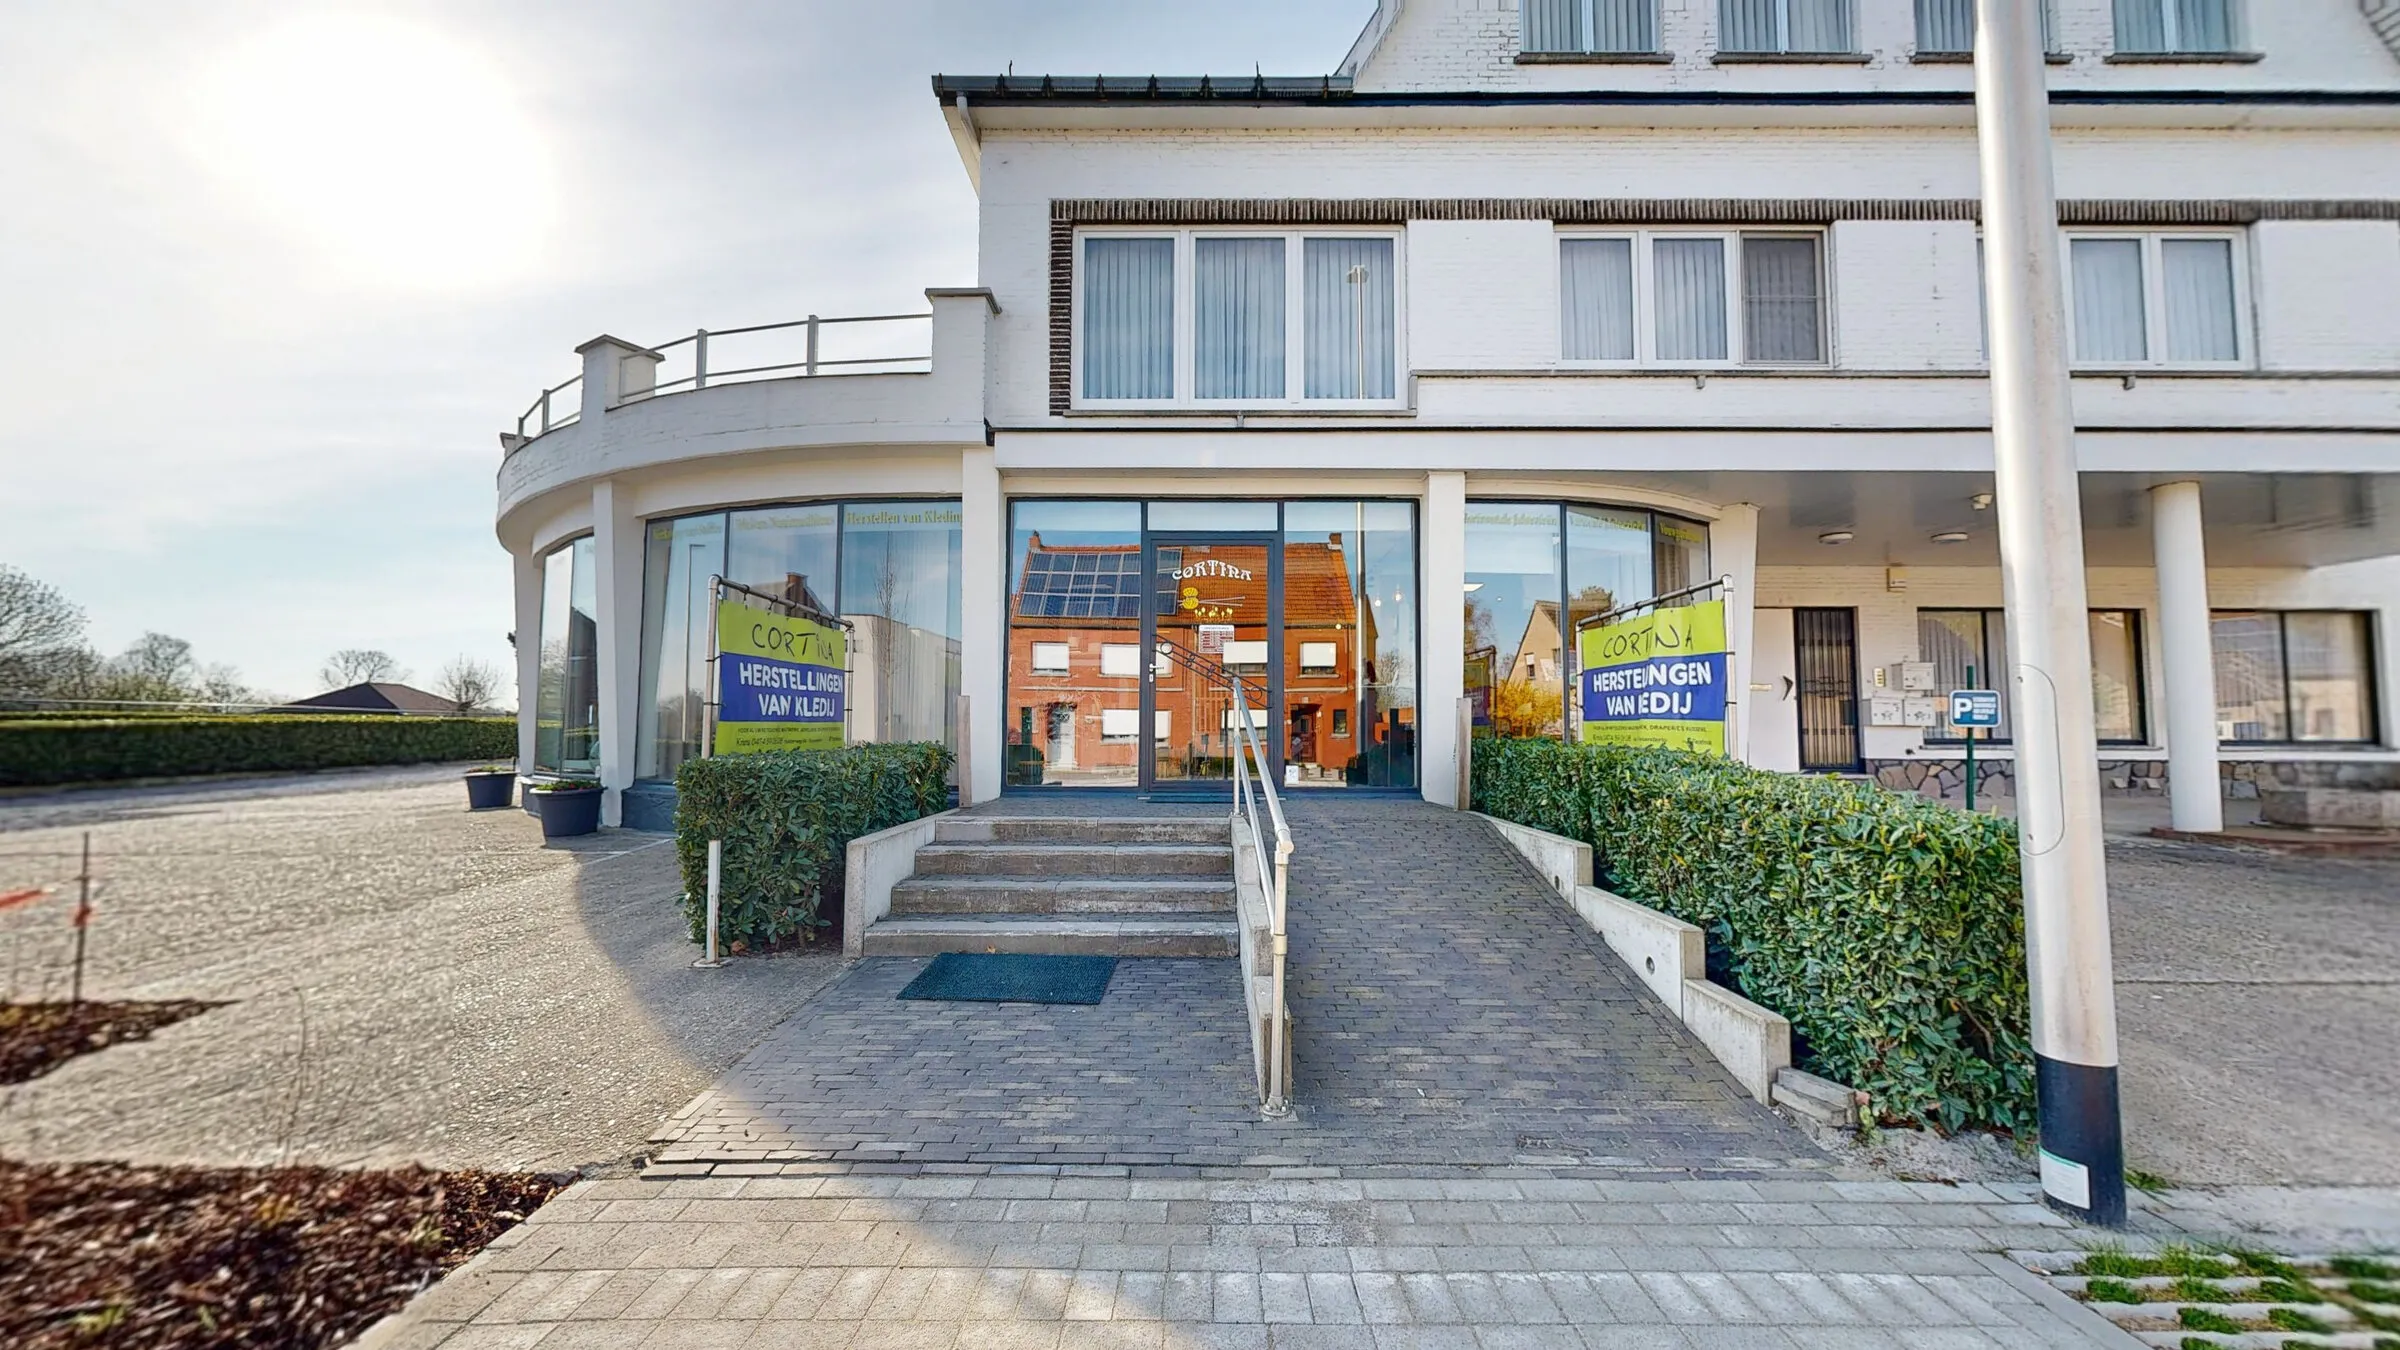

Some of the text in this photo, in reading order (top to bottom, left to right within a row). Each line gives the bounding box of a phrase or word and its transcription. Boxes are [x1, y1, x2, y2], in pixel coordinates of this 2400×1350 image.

[902, 513, 922, 524] van
[924, 509, 962, 524] Kledin
[1172, 559, 1252, 581] CORTINA
[739, 662, 844, 693] HERSTELLINGEN
[758, 693, 835, 717] VAN KLEDIJ
[1606, 695, 1635, 716] VAN
[1954, 697, 1973, 719] P
